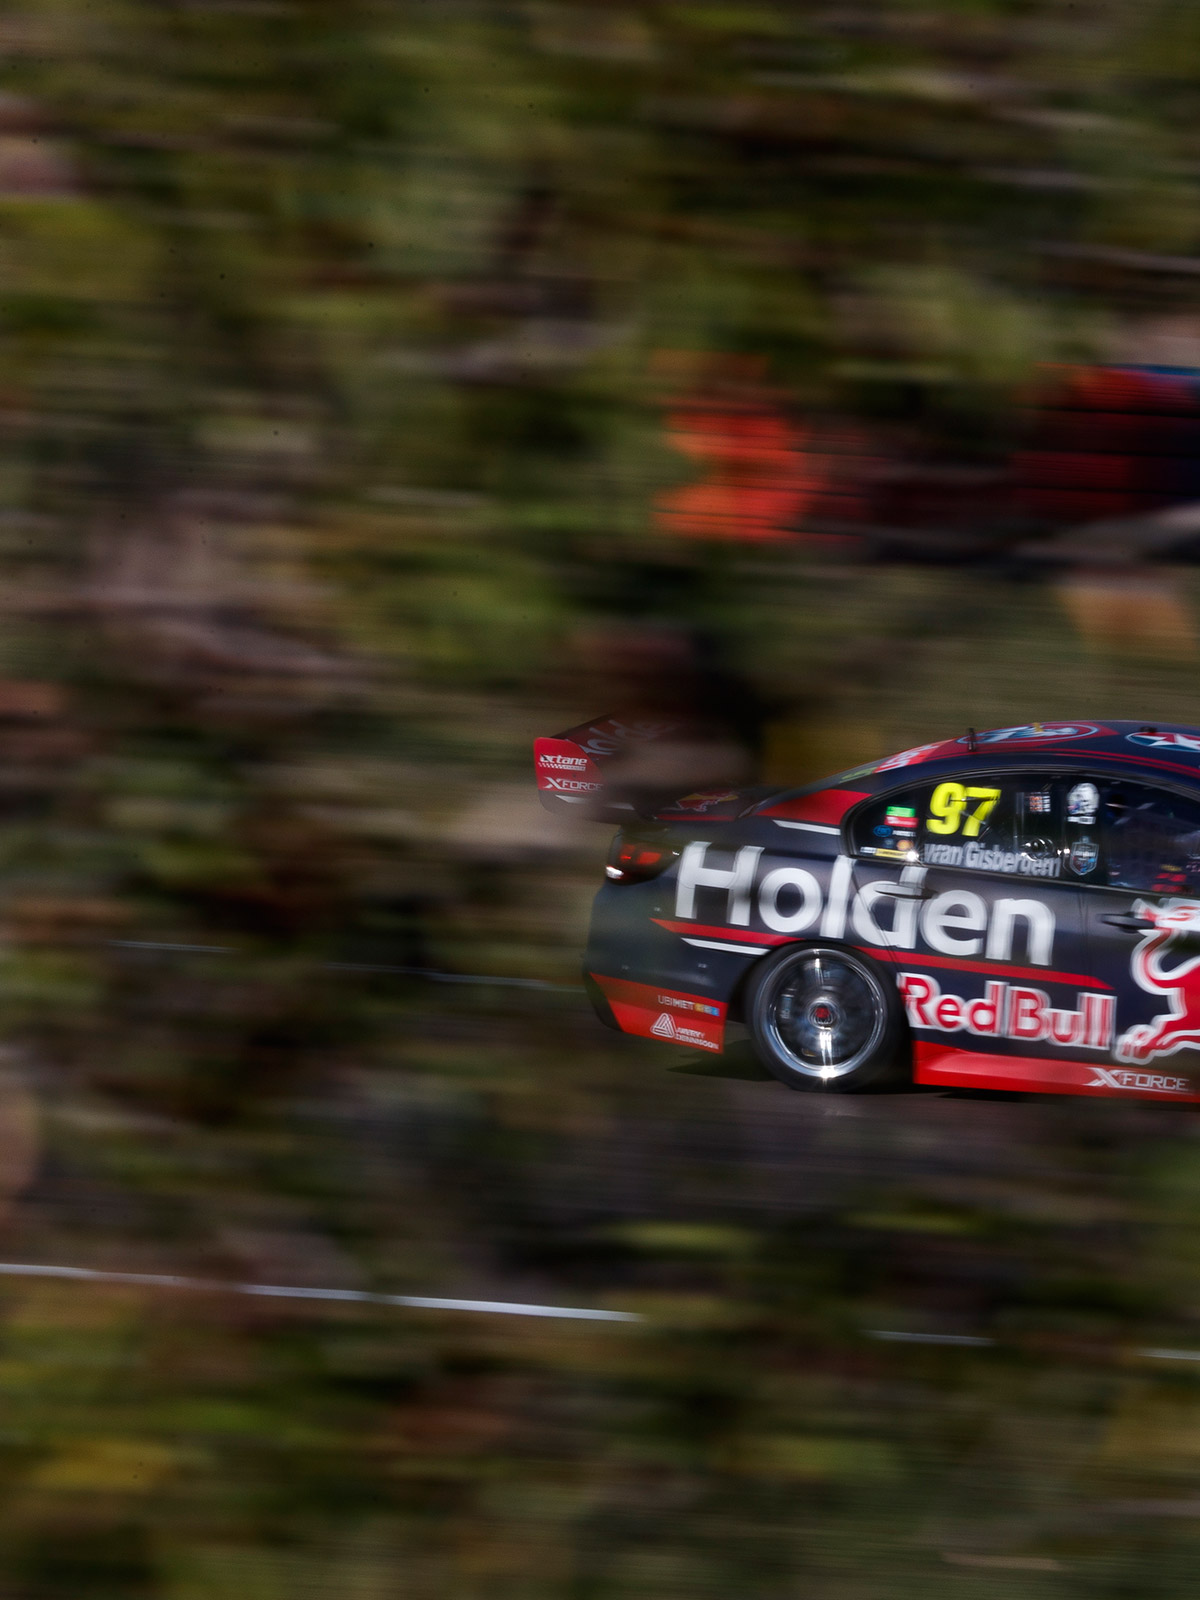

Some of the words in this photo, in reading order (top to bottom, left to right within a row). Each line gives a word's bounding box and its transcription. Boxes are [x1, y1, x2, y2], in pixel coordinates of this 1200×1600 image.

[926, 782, 1001, 837] 97
[924, 843, 963, 867] van
[675, 841, 1056, 966] Holden
[896, 972, 1009, 1038] Red
[1003, 985, 1118, 1050] Bull
[1083, 1067, 1191, 1093] XFORCE
